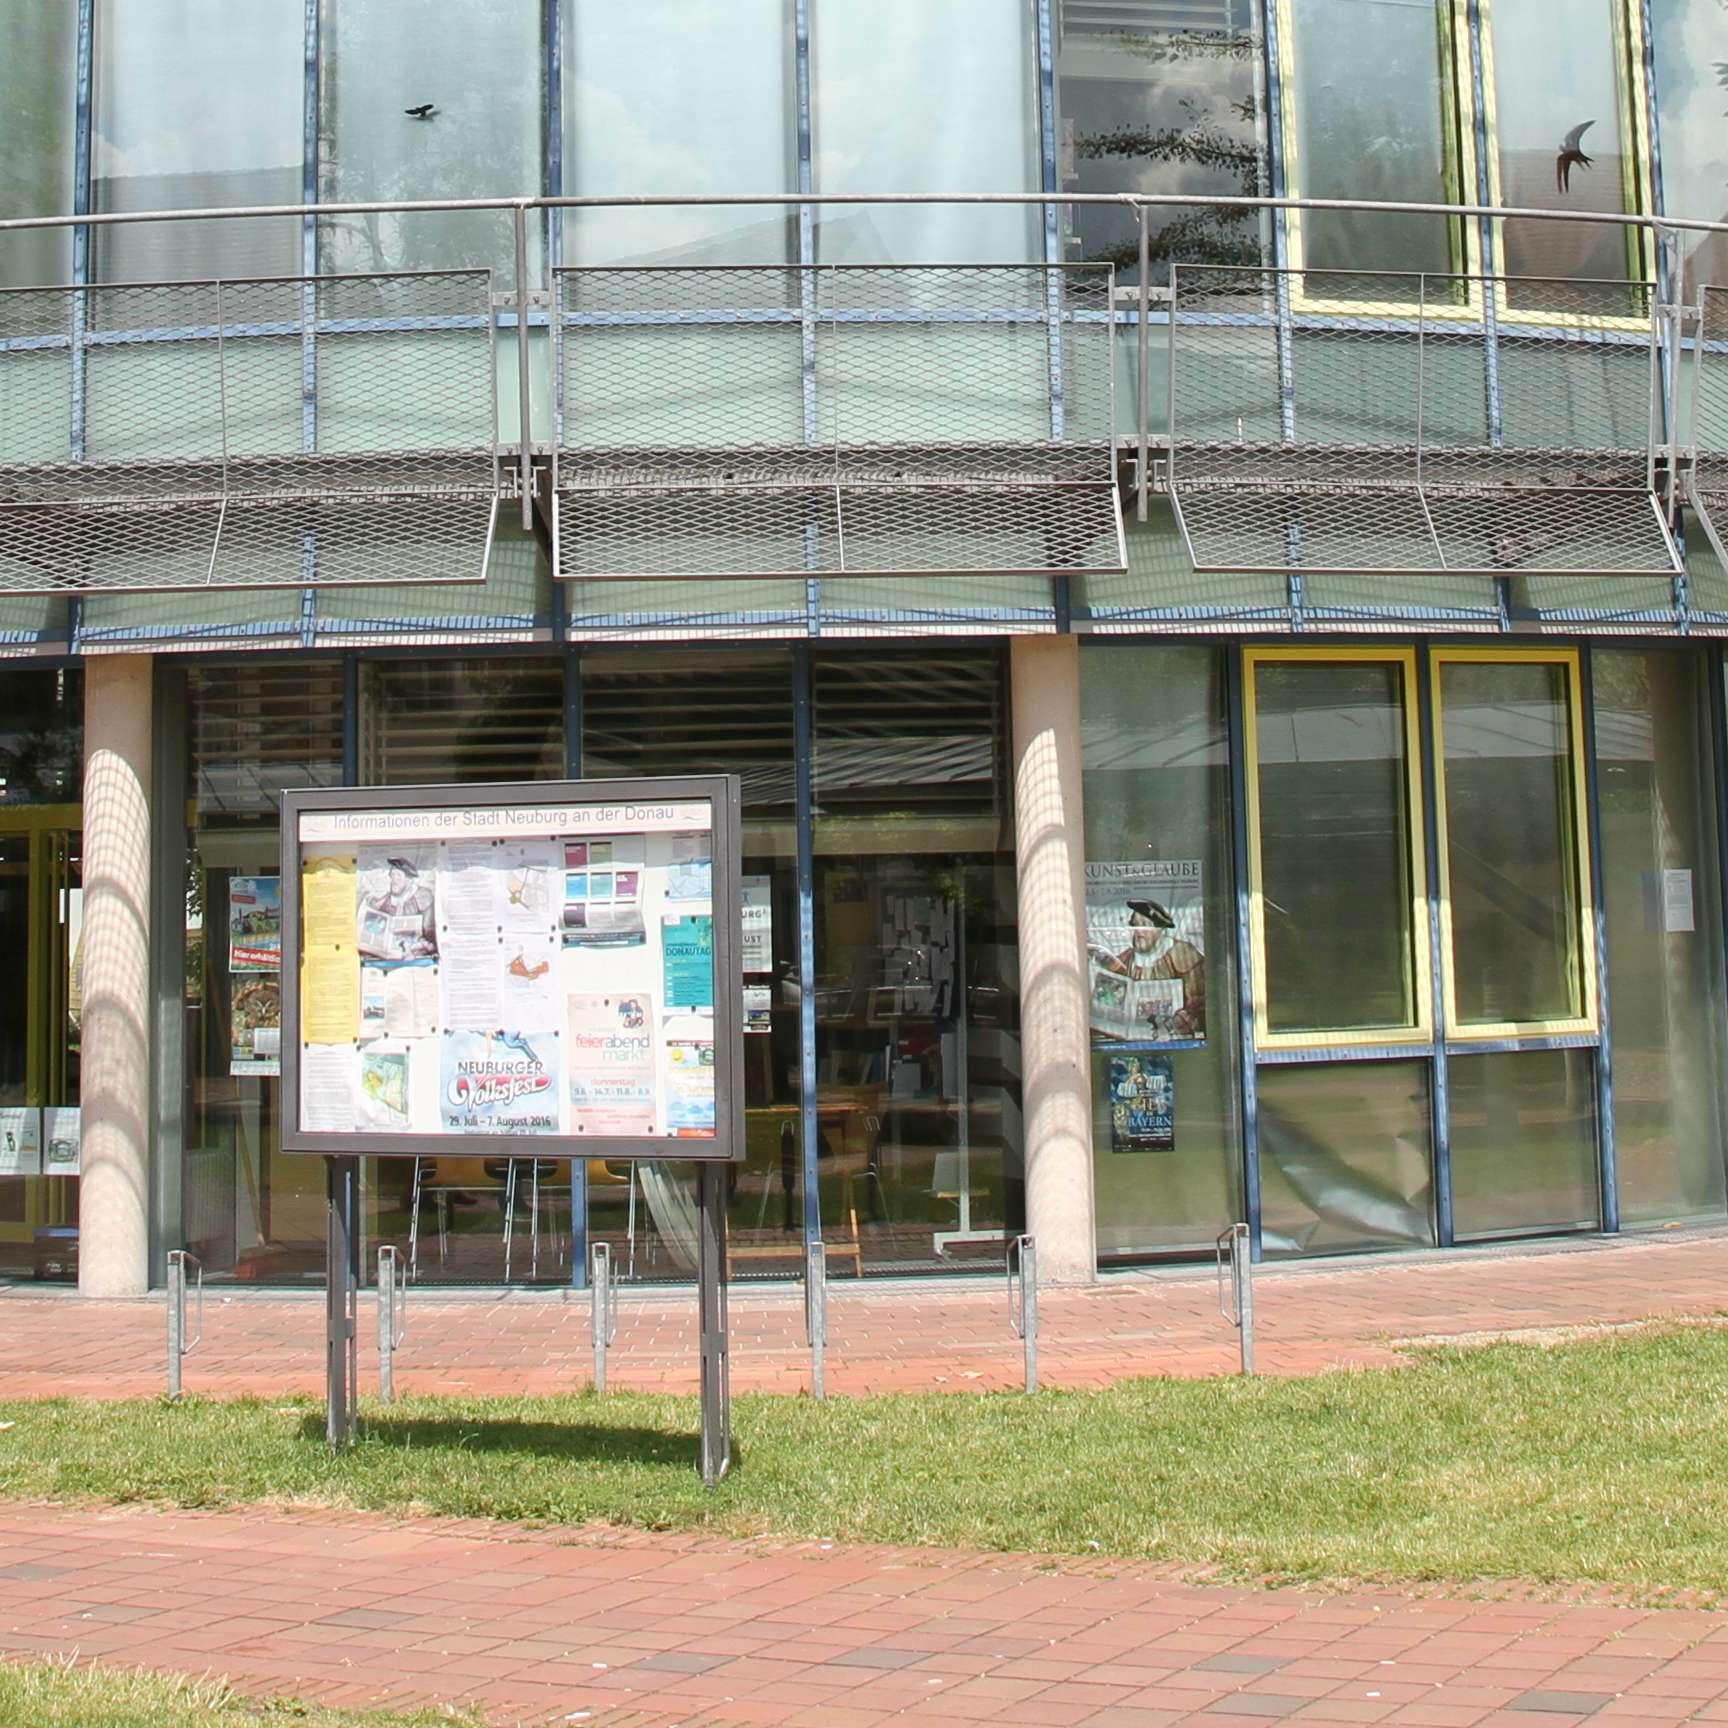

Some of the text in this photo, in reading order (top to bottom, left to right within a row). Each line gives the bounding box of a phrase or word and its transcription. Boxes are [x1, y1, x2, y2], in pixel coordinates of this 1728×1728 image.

[334, 805, 674, 829] Informationen der Stadt Neuburg an der Donau
[575, 1033, 650, 1049] feierabend
[602, 1049, 646, 1062] markt
[457, 1060, 543, 1075] NEUBURGER
[446, 1075, 552, 1113] Volksfest
[464, 1114, 478, 1127] Juli
[496, 1115, 528, 1129] August
[531, 1115, 552, 1127] 2016
